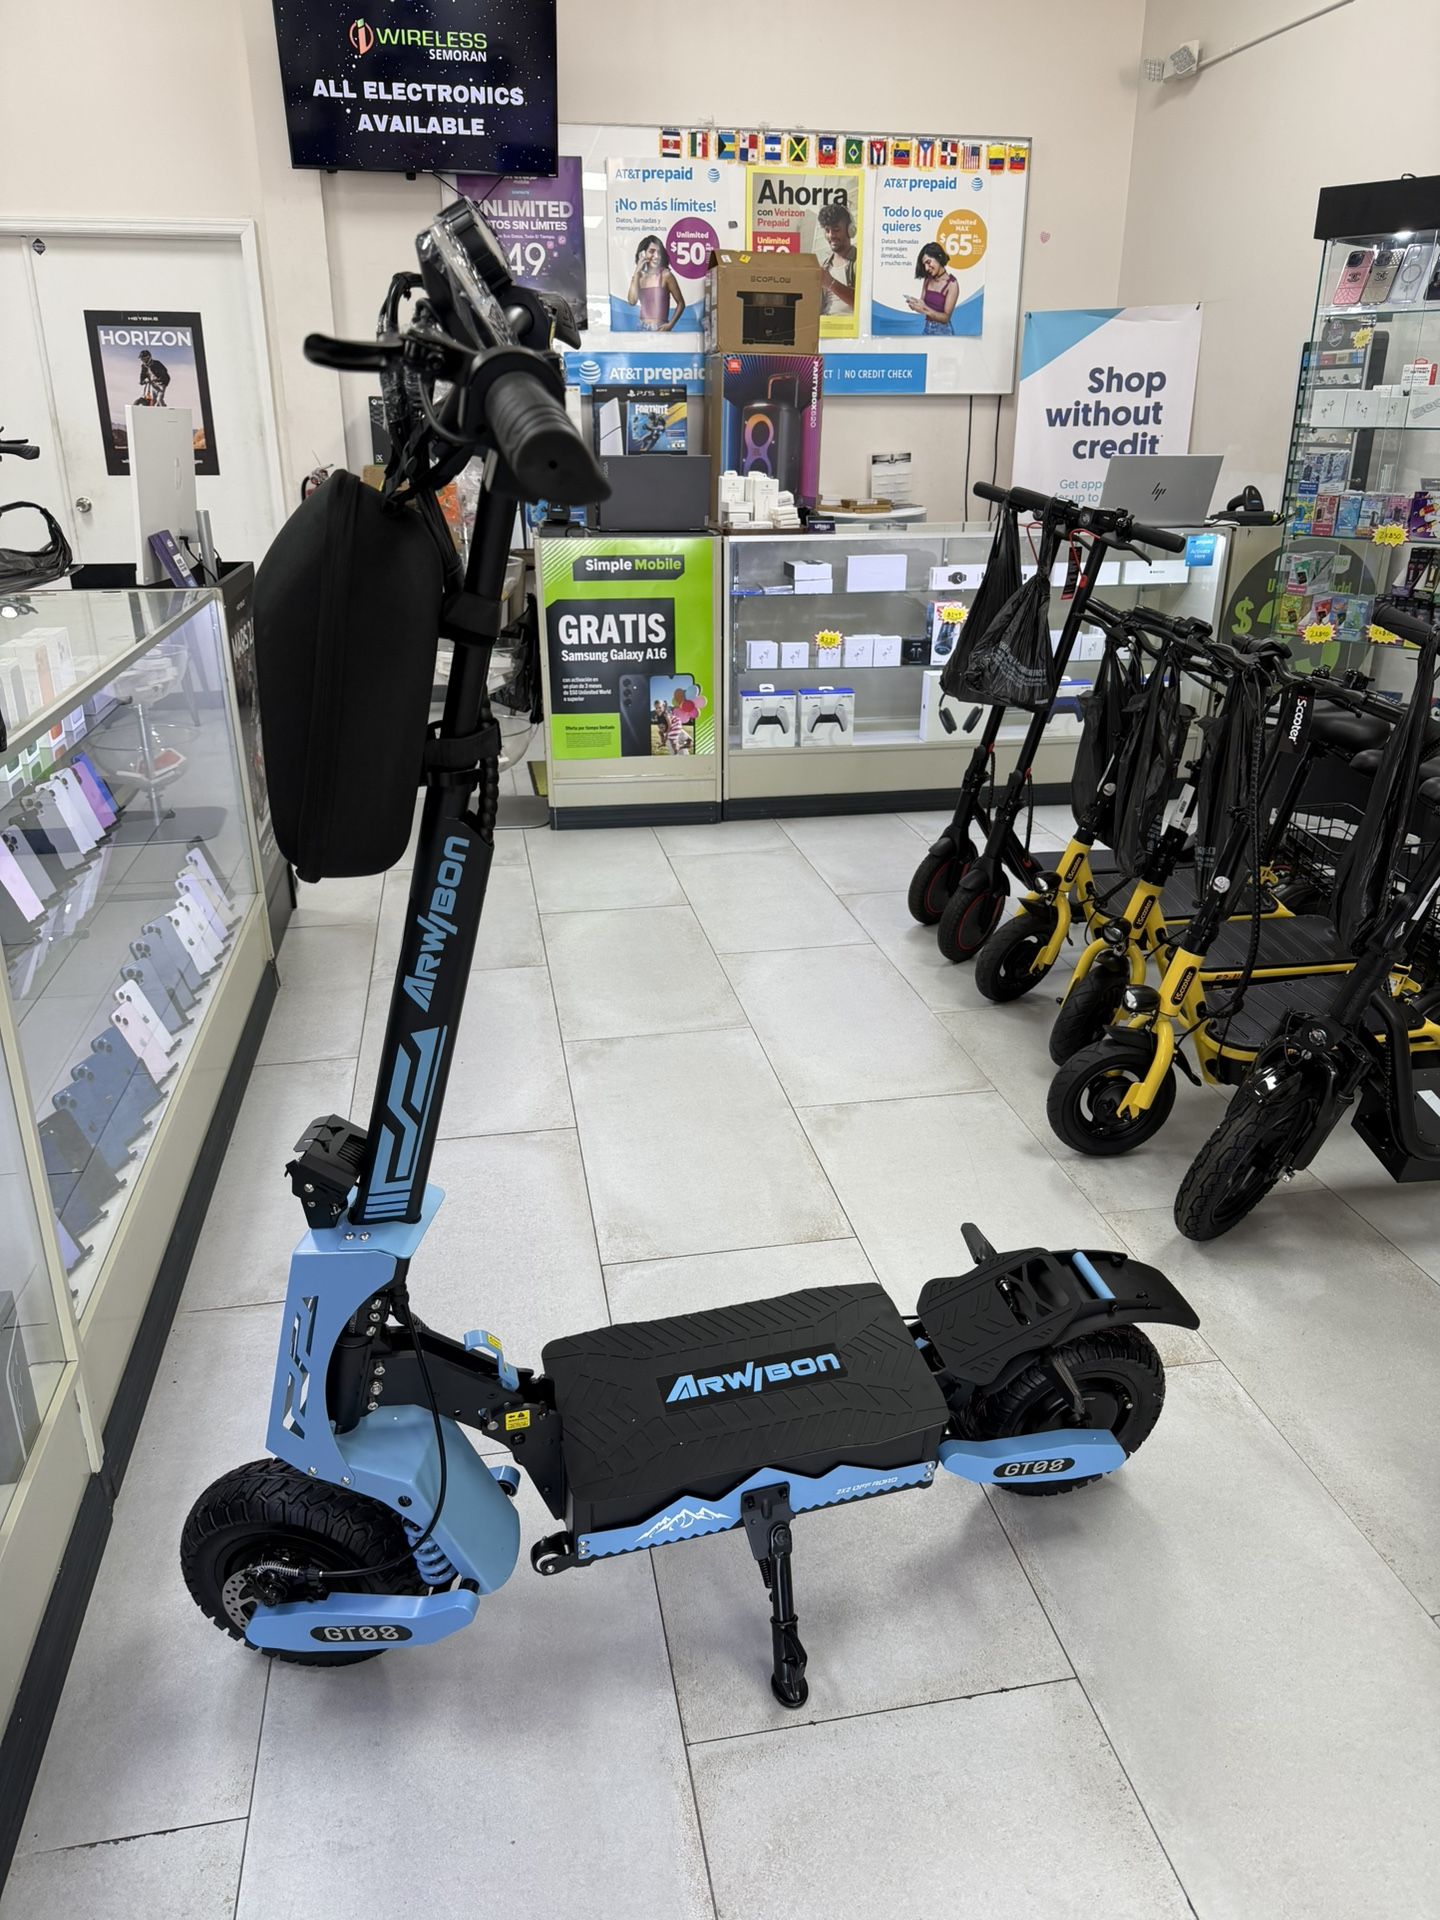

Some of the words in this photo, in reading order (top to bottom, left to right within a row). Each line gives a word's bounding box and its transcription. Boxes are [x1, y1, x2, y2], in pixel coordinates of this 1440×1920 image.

[377, 28, 488, 49] WIRELESS
[429, 49, 487, 62] SEMORAN
[313, 79, 357, 98] ALL
[363, 81, 524, 105] ELECTRONICS
[358, 114, 485, 136] AVAILABLE
[616, 169, 641, 179] AT&T
[642, 167, 693, 182] prepaid
[884, 178, 908, 188] AT&T
[909, 176, 957, 191] prepaid
[757, 179, 848, 206] Ahorra
[480, 200, 573, 218] NLIMITED
[615, 198, 637, 213] ¡No
[640, 197, 668, 211] más
[670, 198, 717, 213] límites!
[774, 208, 806, 217] Verizon
[883, 205, 909, 218] Todo
[912, 206, 921, 217] lo
[923, 208, 944, 220] que
[487, 220, 511, 230] TOS
[512, 220, 530, 230] SIN
[531, 219, 568, 231] LÍMITES
[757, 218, 790, 228] Prepaid
[882, 221, 922, 234] quieres
[676, 231, 709, 239] Unlimited
[757, 236, 791, 245] Unlimited
[939, 233, 973, 256] $65
[670, 241, 705, 266] $50
[750, 275, 791, 283] ECOFLOW
[100, 330, 192, 346] HORIZON
[609, 367, 642, 381] AT&T
[844, 369, 856, 379] NO
[857, 369, 885, 379] CREDIT
[887, 369, 913, 379] CHECK
[1087, 366, 1167, 398] Shop
[1045, 400, 1163, 427] without
[1072, 432, 1160, 460] credit
[1059, 479, 1079, 489] Get
[1087, 492, 1099, 502] to
[585, 559, 632, 574] Simple
[634, 558, 682, 571] Mobile
[558, 613, 666, 645] GRATIS
[561, 650, 609, 662] Samsung
[610, 649, 644, 660] Galaxy
[646, 648, 667, 659] A16
[1003, 1458, 1066, 1477] GT08
[323, 1625, 399, 1641] GT08
